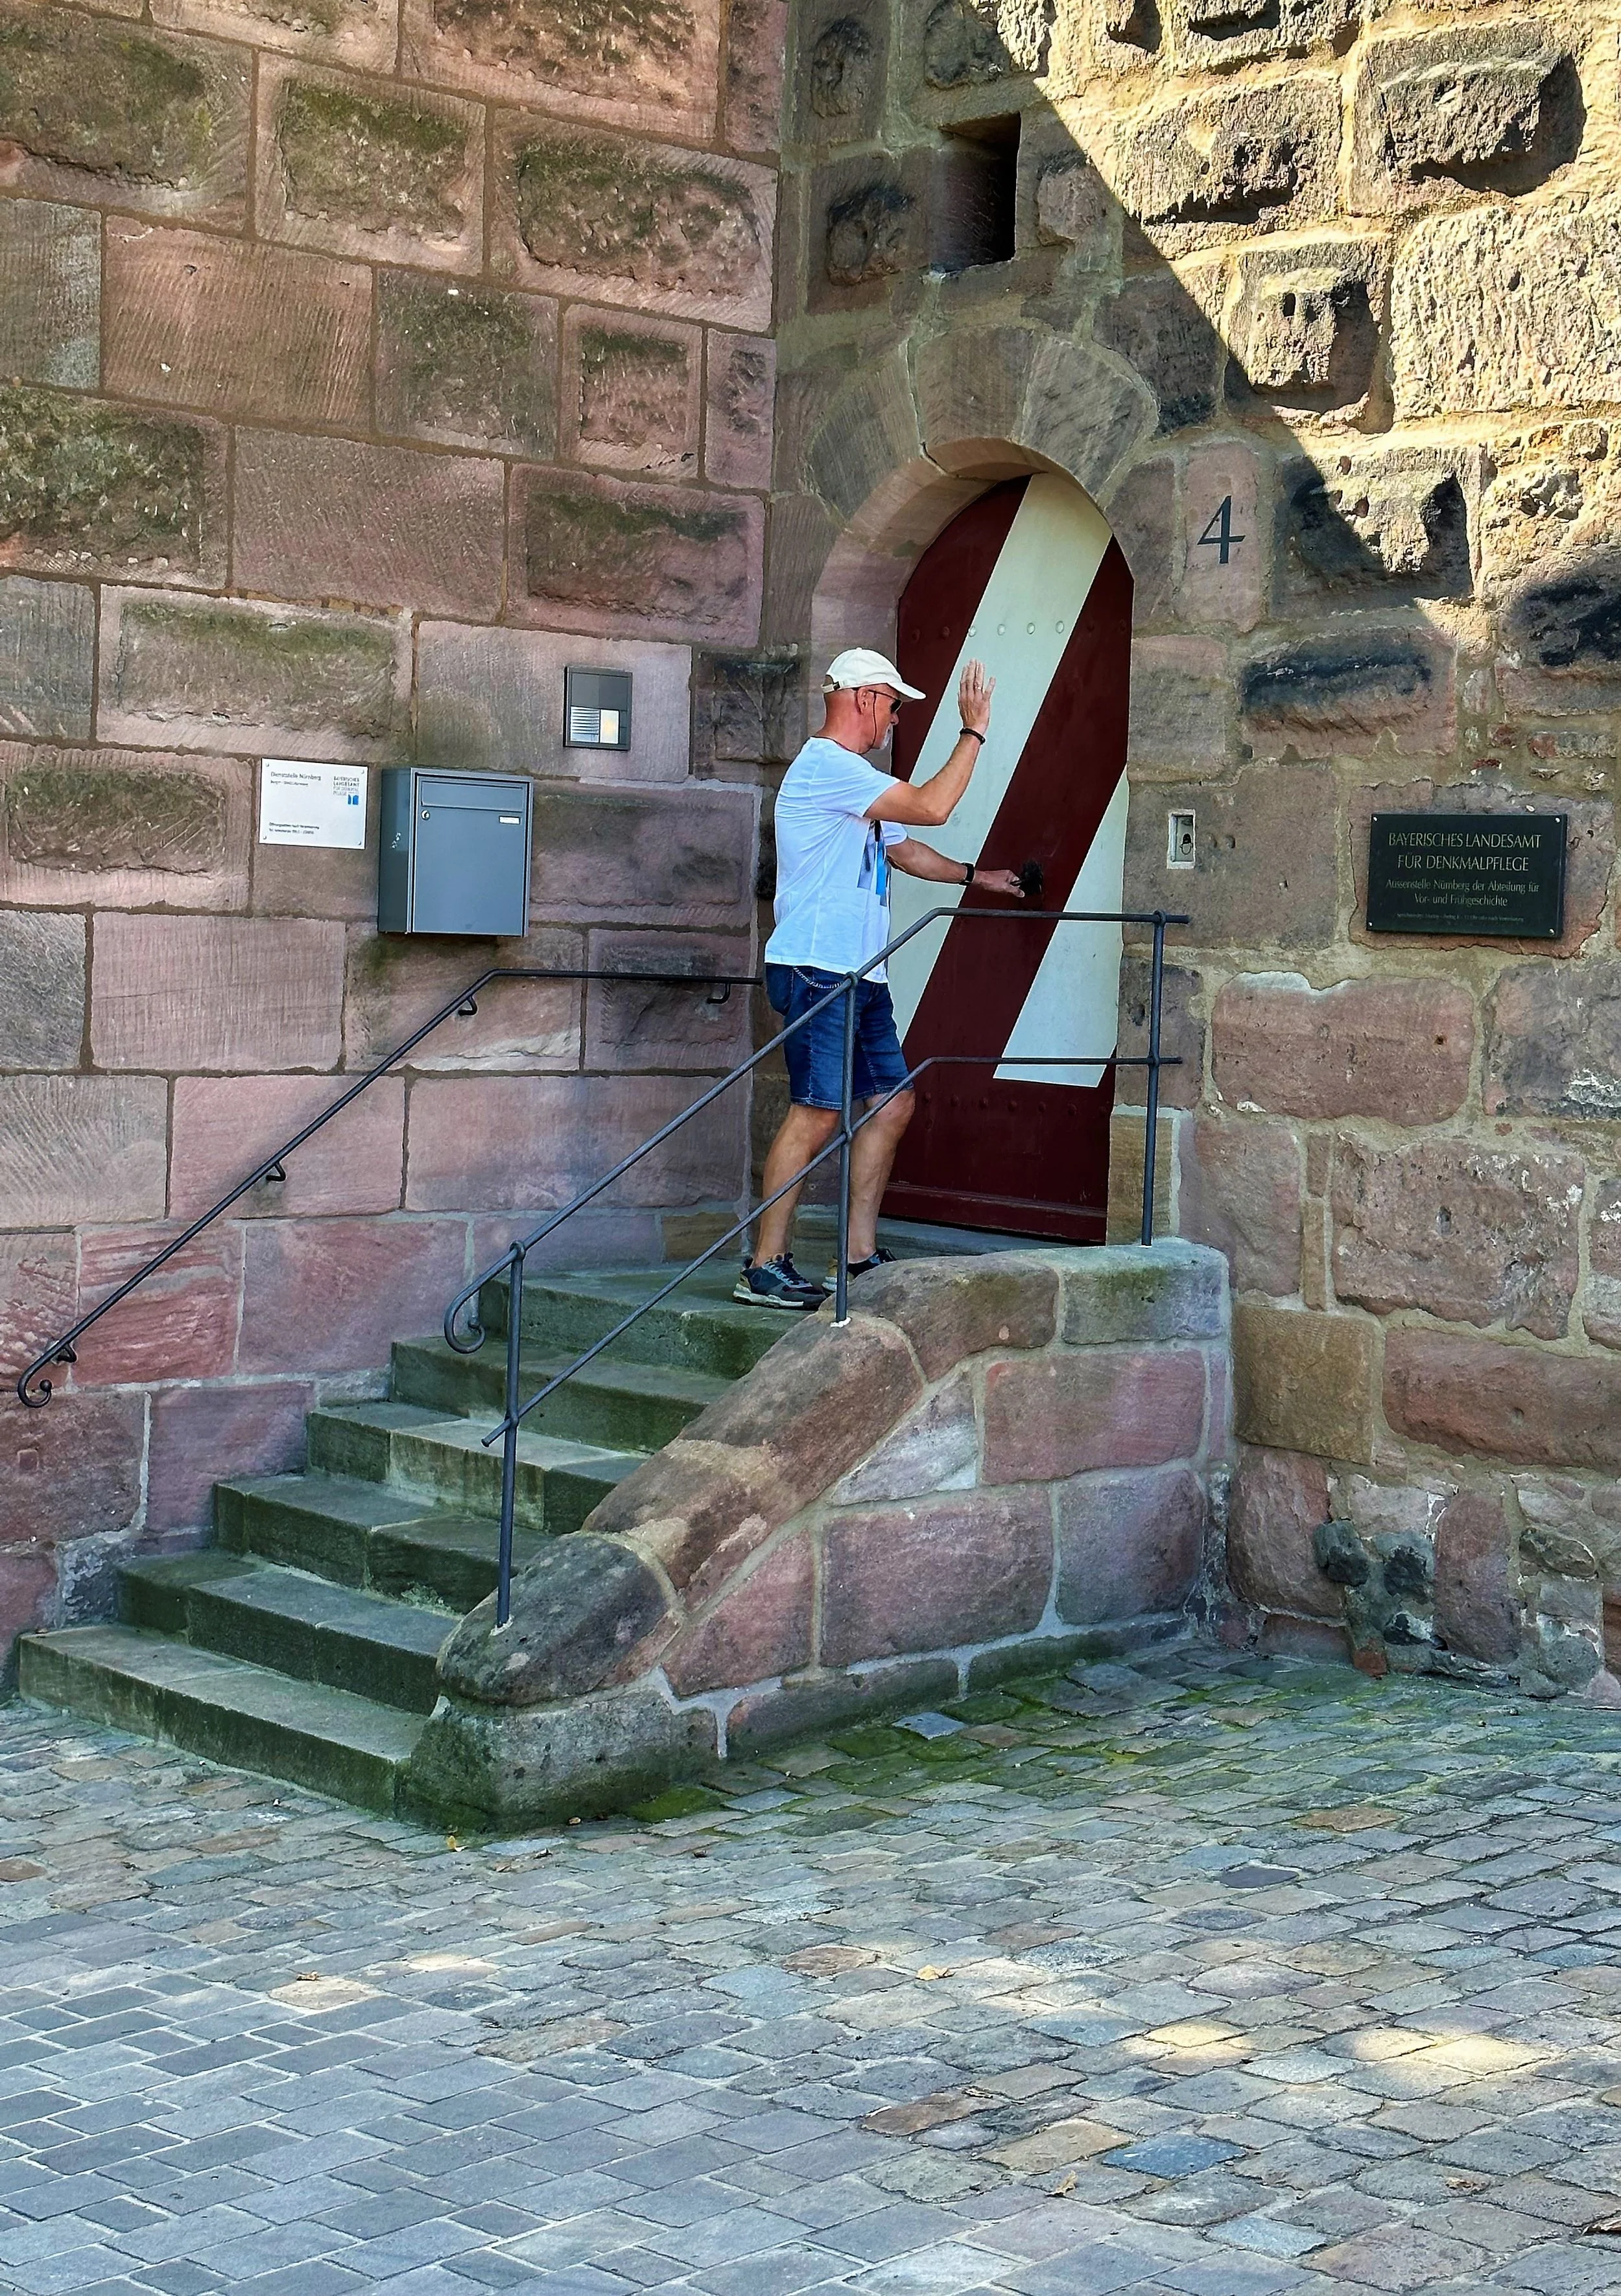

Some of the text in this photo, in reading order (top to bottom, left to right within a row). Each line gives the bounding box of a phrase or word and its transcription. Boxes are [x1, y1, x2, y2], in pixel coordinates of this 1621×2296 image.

[1197, 495, 1246, 563] 4
[1388, 832, 1542, 849] BAYERISCHES LANDESAMT
[1397, 852, 1530, 871] FÜR DENKMALPFLEGE
[1433, 879, 1470, 892] Nürnberg
[1472, 880, 1485, 891] der
[1487, 880, 1526, 895] Abteilung
[1528, 881, 1540, 893] für
[1414, 893, 1508, 907] Vor- und Frühgeschichte
